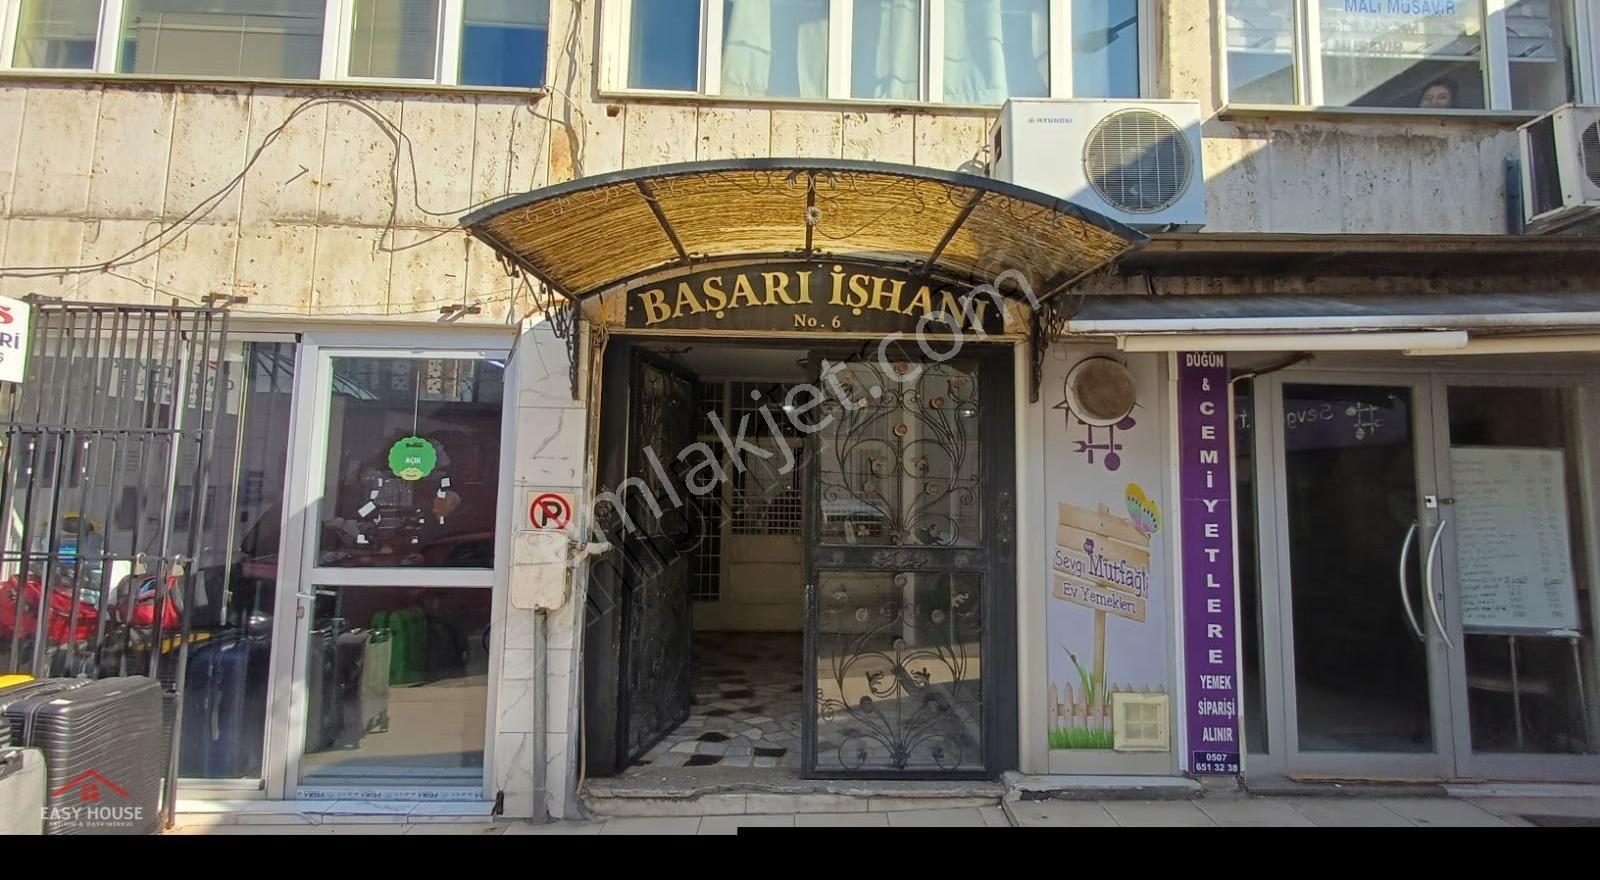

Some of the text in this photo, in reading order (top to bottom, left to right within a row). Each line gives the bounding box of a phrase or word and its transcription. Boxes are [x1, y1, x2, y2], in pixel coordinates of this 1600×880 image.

[637, 264, 990, 332] BAŞARI İŞHANI
[831, 315, 841, 328] 6
[1185, 351, 1224, 368] DÜĞÜN
[1202, 377, 1211, 391] &
[1199, 402, 1223, 664] CEMİYETLERE
[1063, 582, 1078, 598] Ev
[1200, 675, 1232, 690] YEMEK
[1198, 698, 1235, 720] SİPARİŞİ
[1202, 727, 1233, 742] ALINIR
[1206, 753, 1228, 762] 0507
[1195, 762, 1211, 771] 651
[1214, 763, 1225, 772] 32
